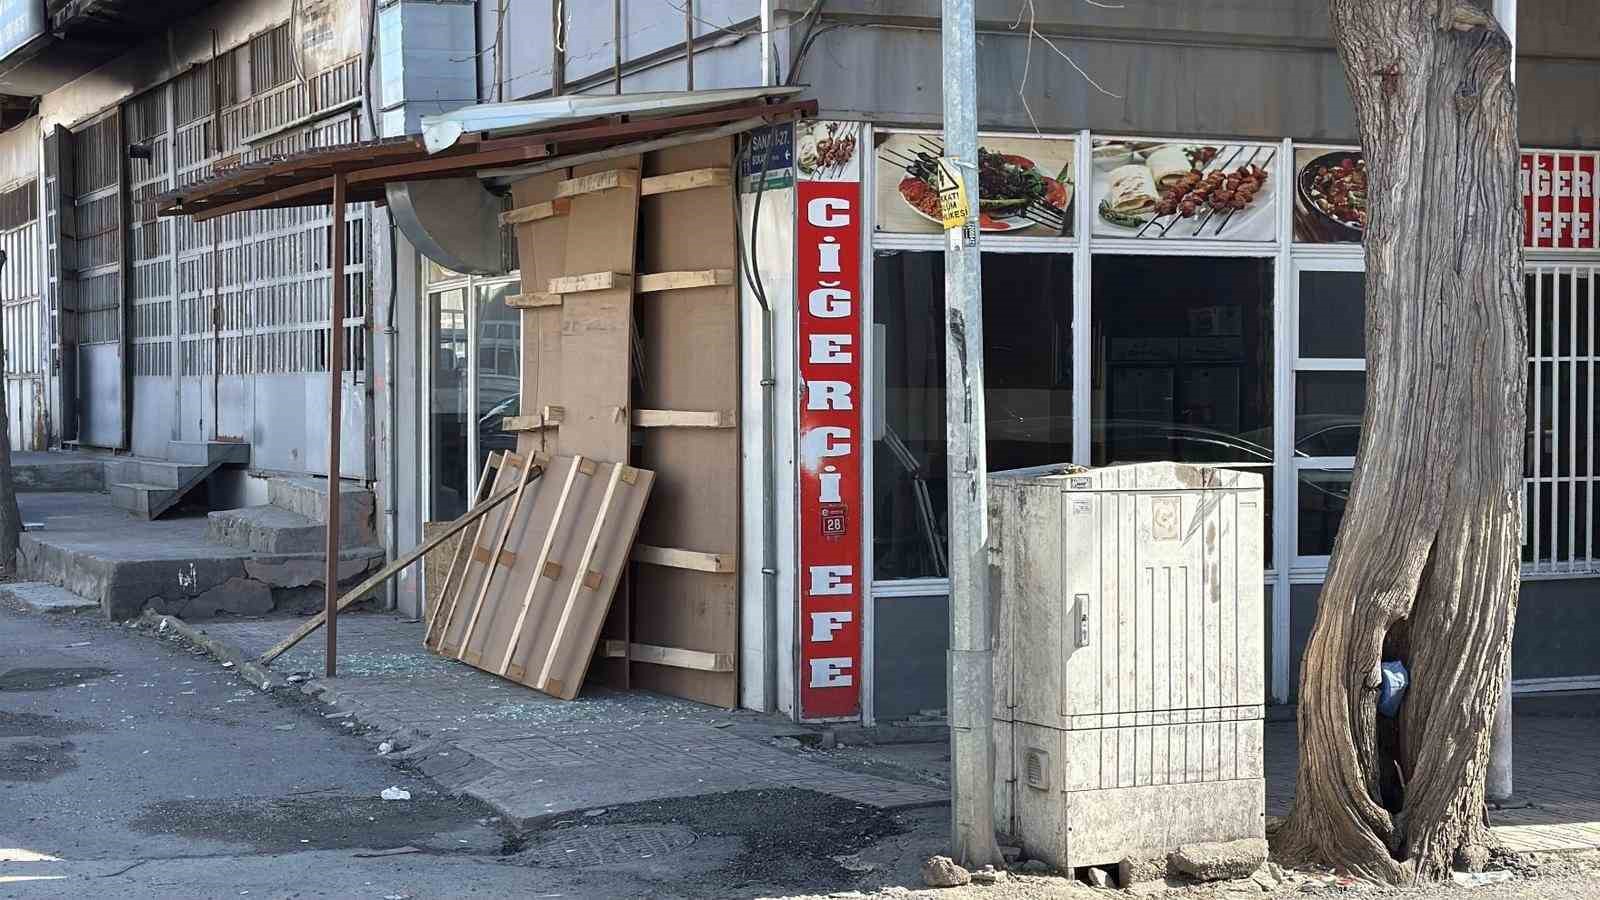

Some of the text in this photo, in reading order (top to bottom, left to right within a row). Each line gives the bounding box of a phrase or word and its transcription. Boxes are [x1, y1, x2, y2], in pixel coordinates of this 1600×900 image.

[1535, 212, 1590, 239] EFE
[806, 197, 853, 503] CİĞERCİ
[827, 518, 841, 531] 28
[809, 565, 853, 688] EFE
